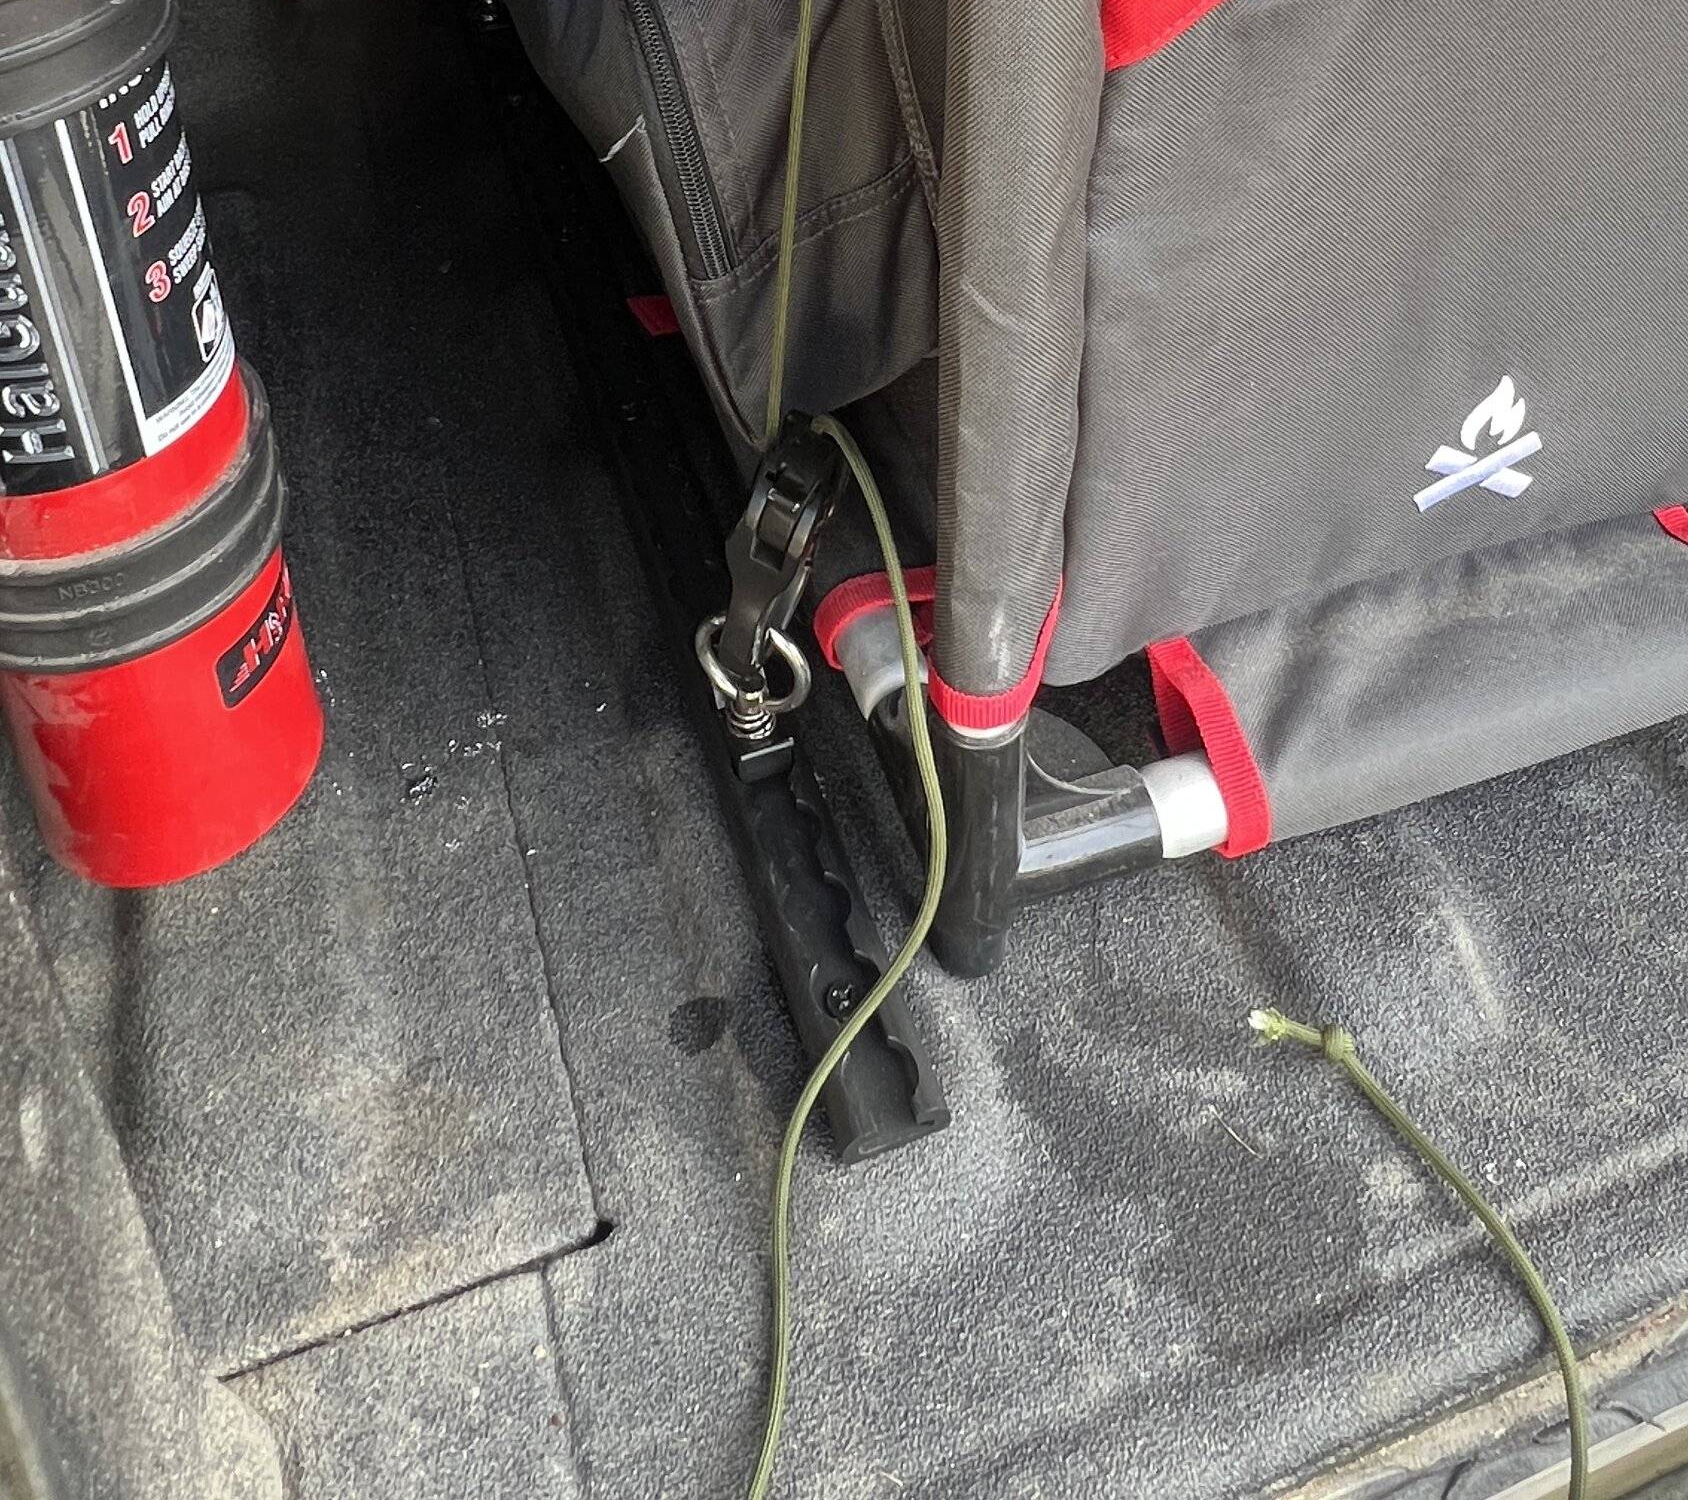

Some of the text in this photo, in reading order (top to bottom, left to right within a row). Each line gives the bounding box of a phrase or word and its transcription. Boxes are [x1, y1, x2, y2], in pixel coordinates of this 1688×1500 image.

[134, 94, 159, 130] HOLD
[139, 116, 163, 149] PULL
[108, 121, 133, 165] 1
[151, 159, 176, 198] START
[127, 191, 155, 238] 2
[145, 260, 171, 303] 3
